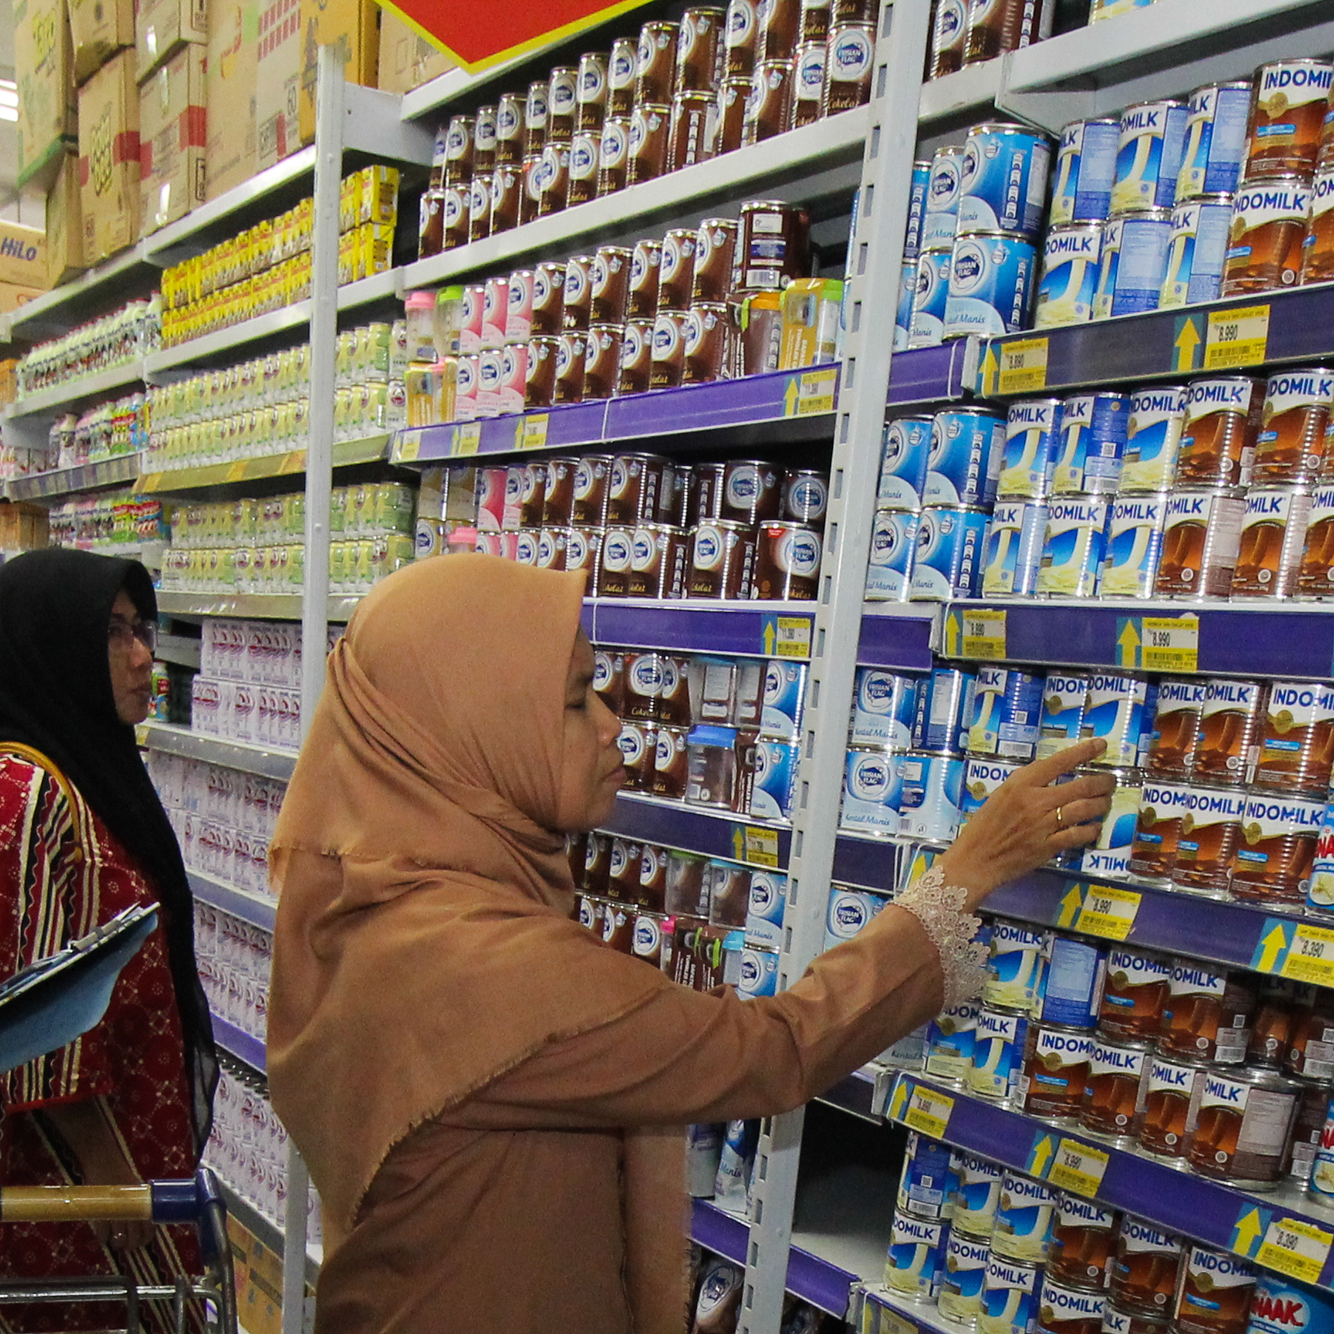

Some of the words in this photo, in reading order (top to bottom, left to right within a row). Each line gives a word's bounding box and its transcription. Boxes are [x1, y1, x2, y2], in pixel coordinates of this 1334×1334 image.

[1217, 324, 1240, 342] 8.990
[1246, 803, 1324, 826] INDOMILK
[1300, 938, 1324, 958] 8.390
